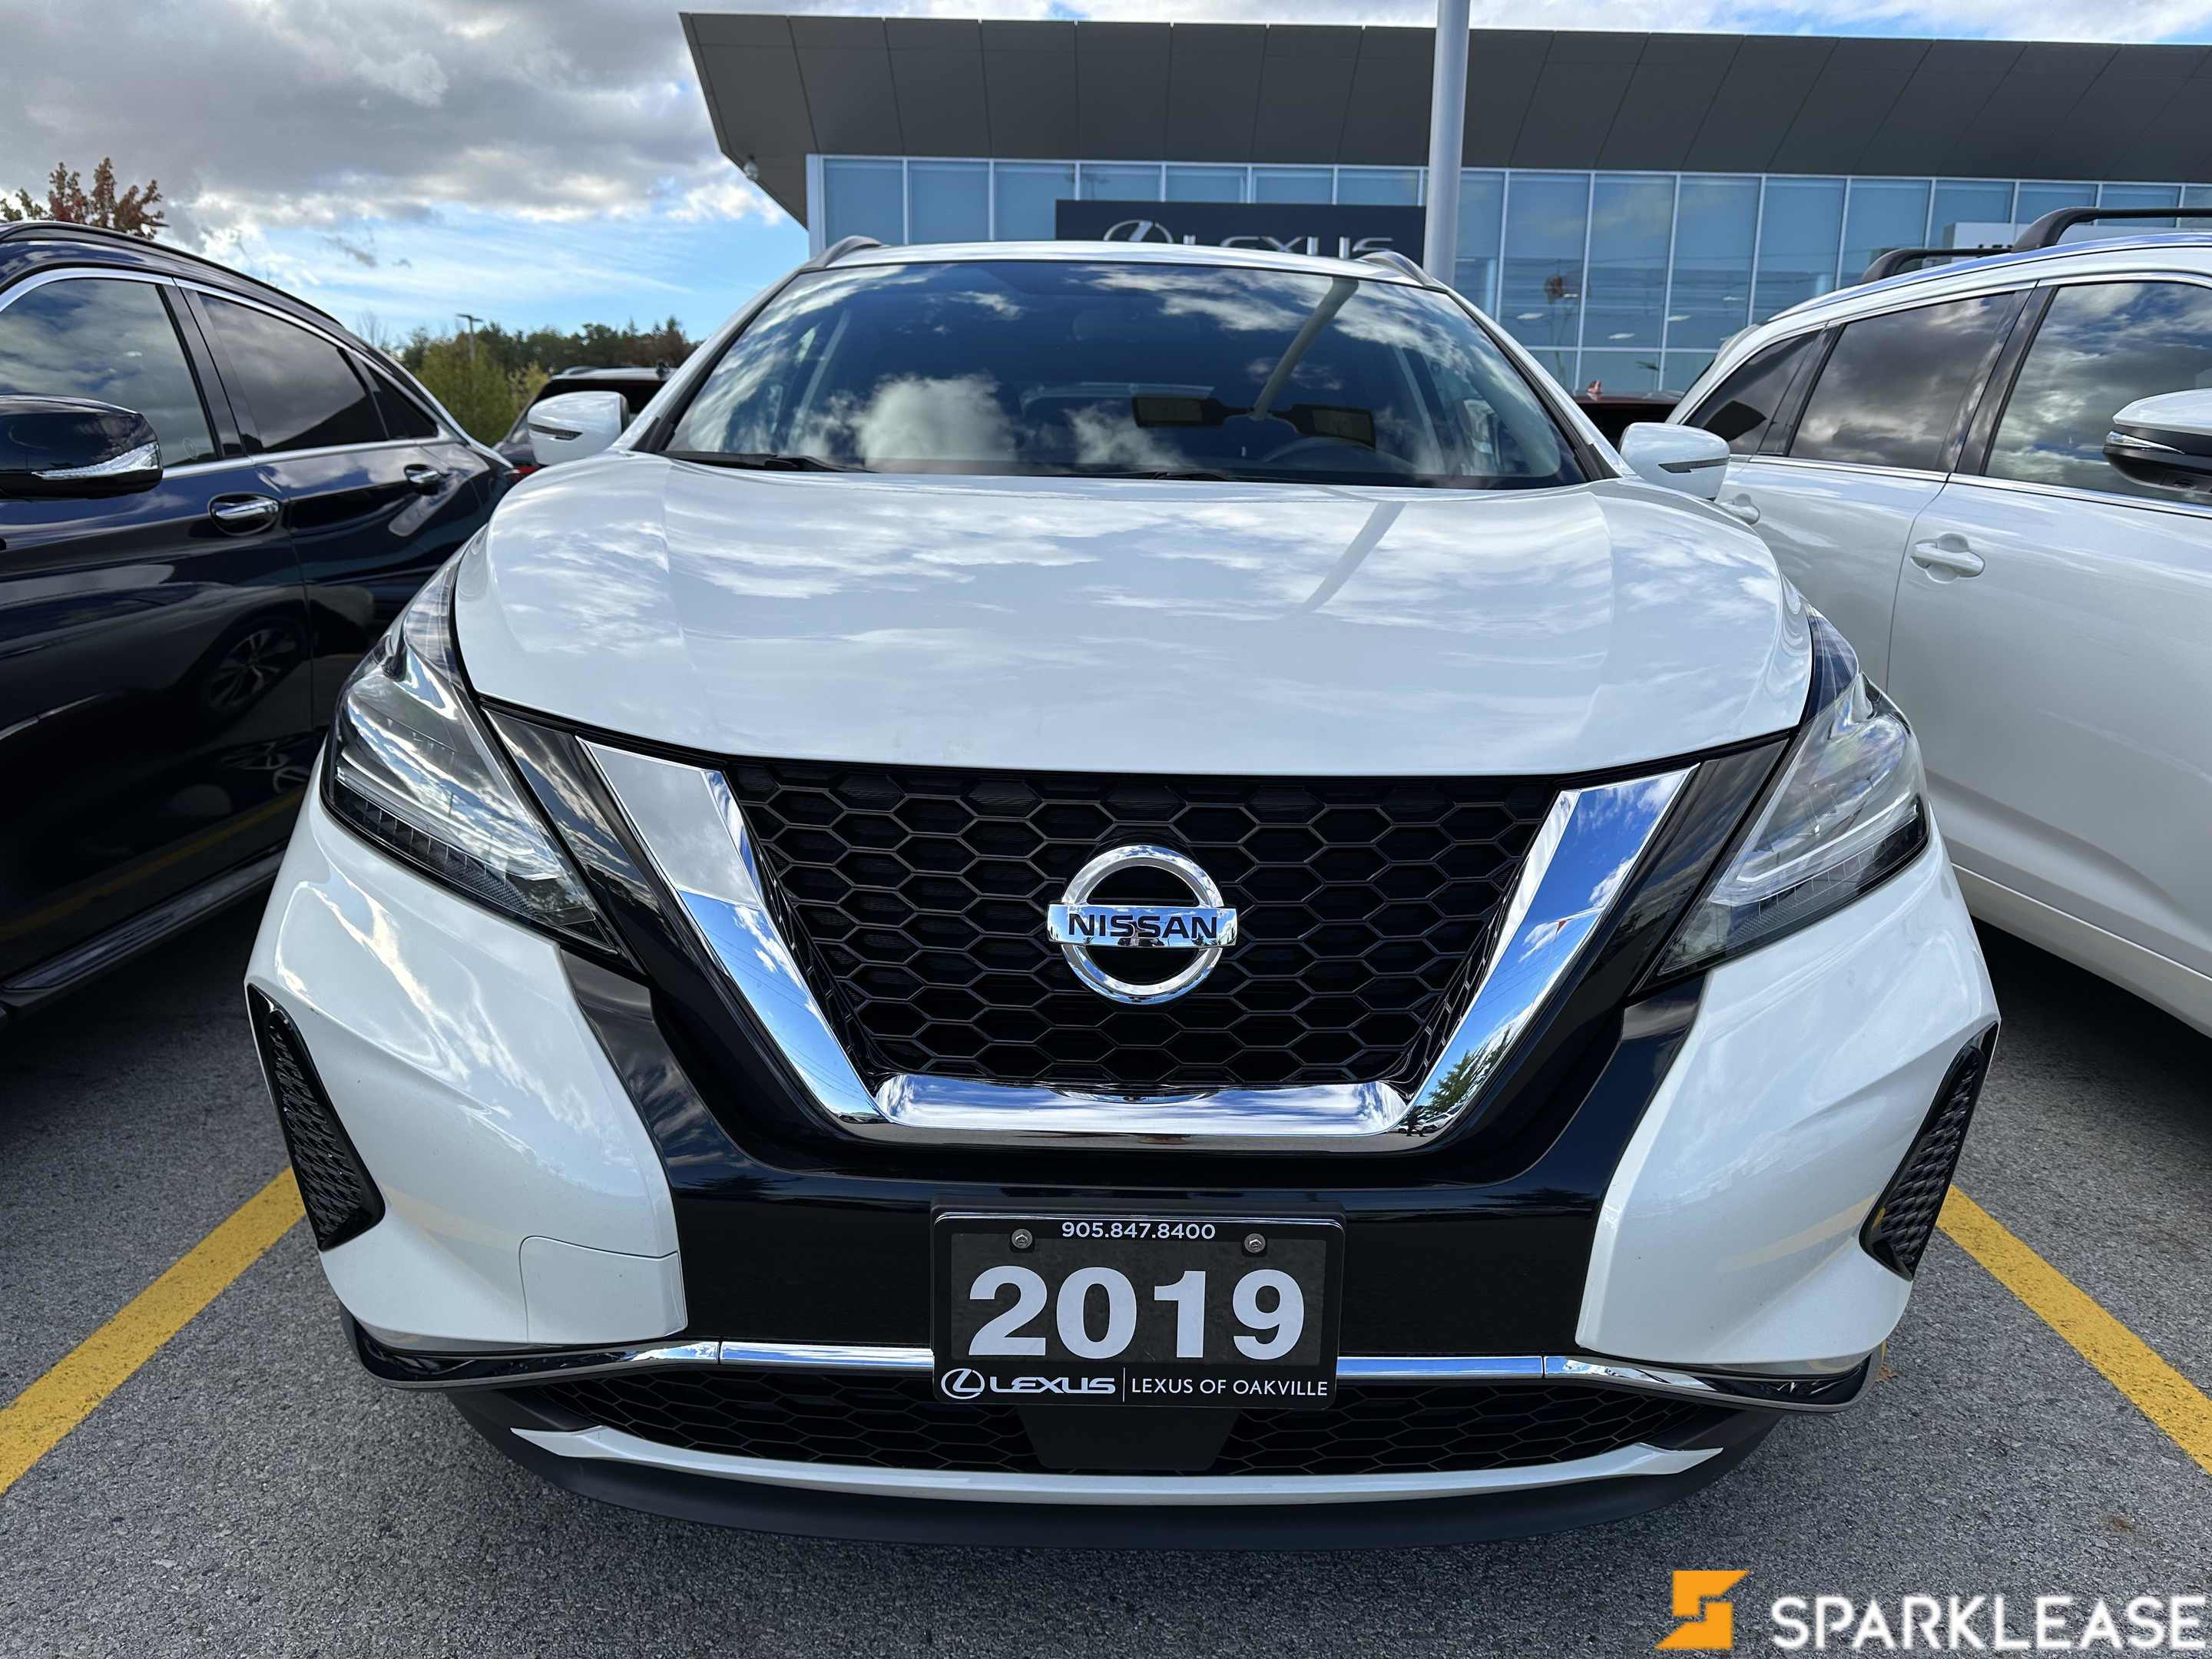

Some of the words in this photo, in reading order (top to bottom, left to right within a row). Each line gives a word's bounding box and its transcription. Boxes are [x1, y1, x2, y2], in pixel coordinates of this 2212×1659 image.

[1068, 913, 1217, 939] NISSAN
[1061, 1221, 1216, 1240] 905.847.8400
[969, 1265, 1305, 1360] 2019
[989, 1376, 1116, 1394] LEXUS
[1131, 1378, 1194, 1394] LEXUS
[1199, 1379, 1227, 1394] OF
[1233, 1379, 1328, 1396] OAKVILLE
